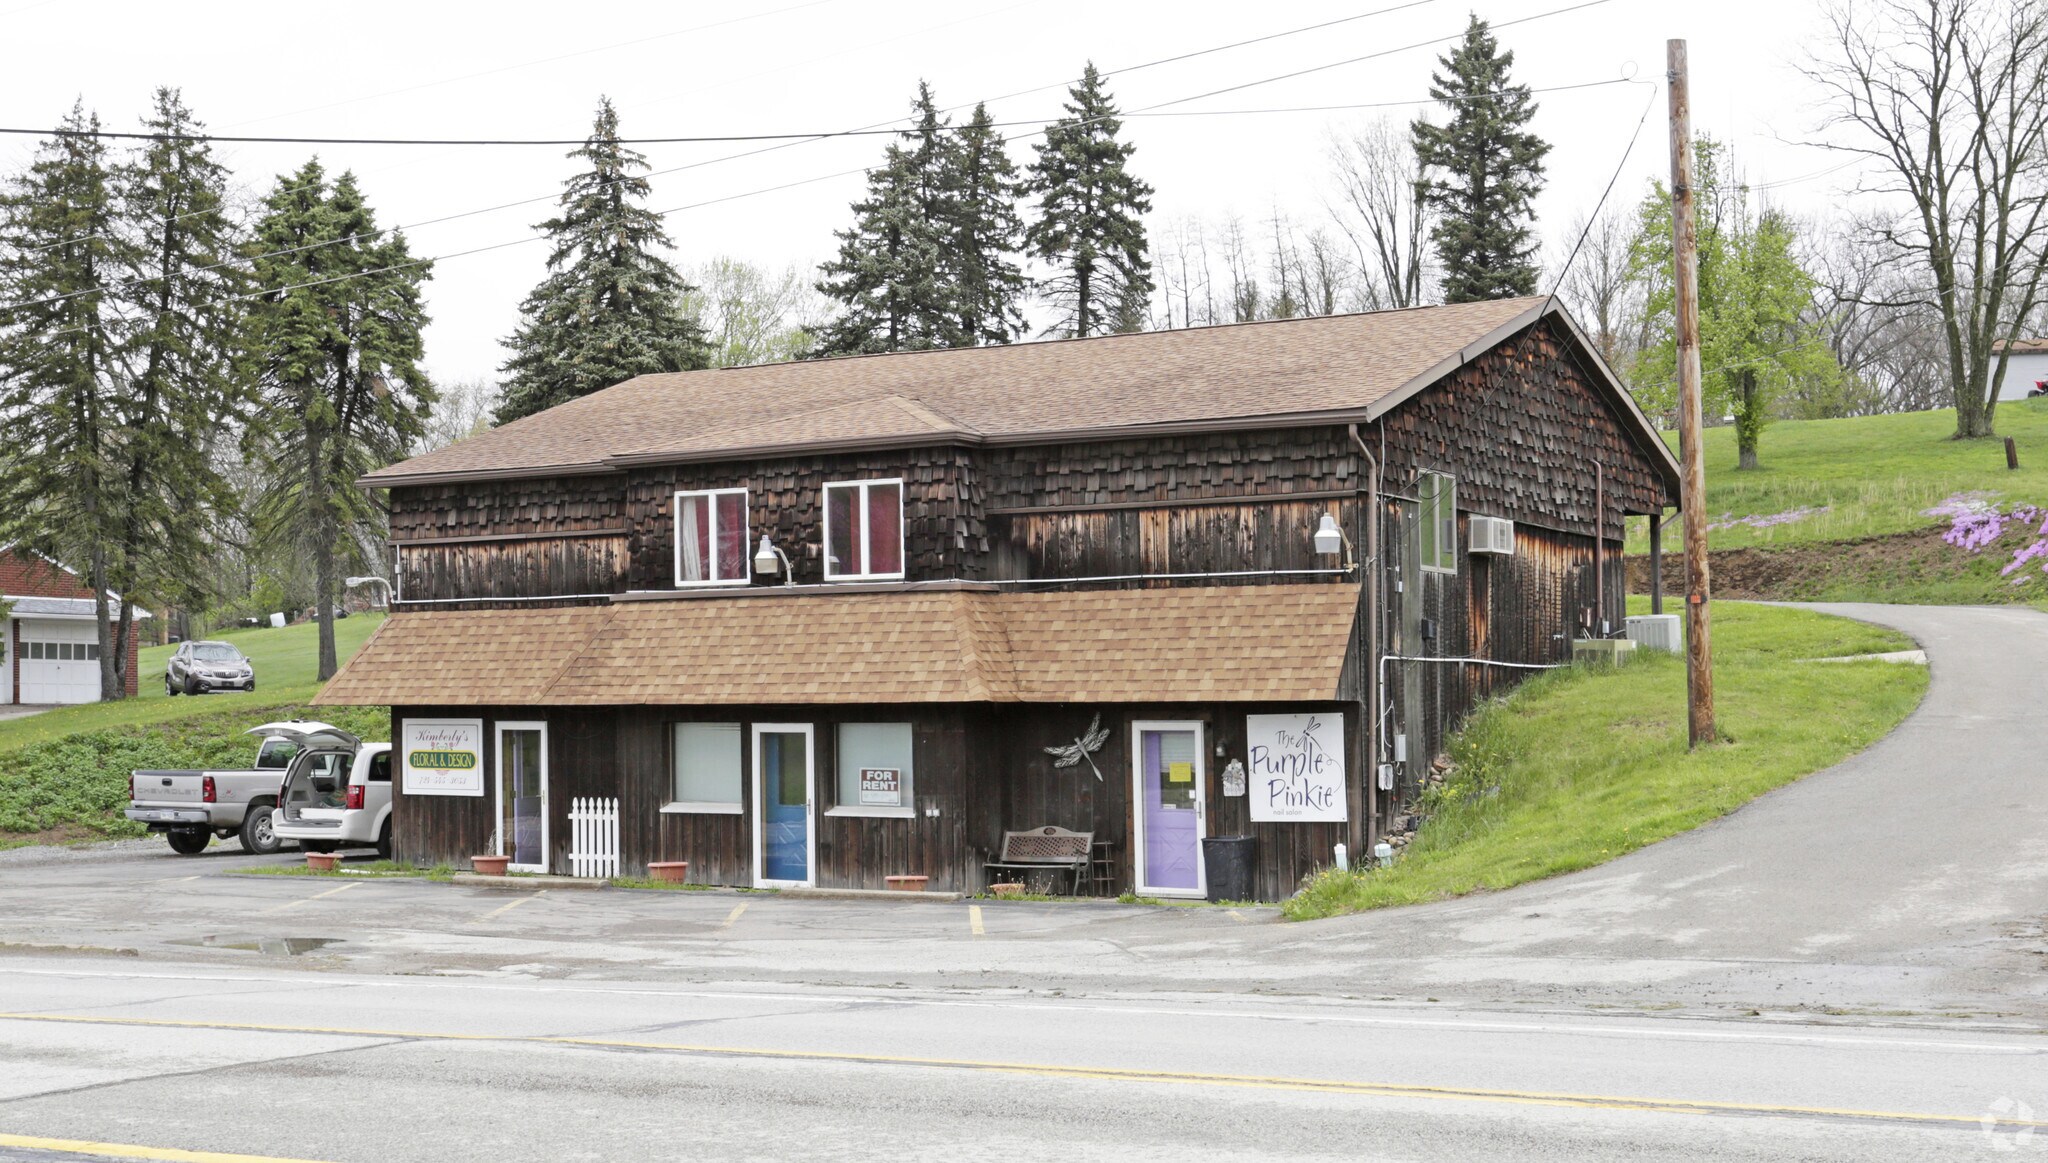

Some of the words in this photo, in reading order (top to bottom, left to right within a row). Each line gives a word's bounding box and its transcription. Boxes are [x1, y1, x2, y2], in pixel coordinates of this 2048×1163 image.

[415, 729, 469, 746] Kimberly's
[1275, 730, 1295, 748] The
[413, 753, 438, 767] FLORAL
[440, 753, 447, 767] &
[448, 753, 472, 767] DESIGN
[1251, 742, 1323, 786] Purple
[866, 771, 892, 780] FOR
[137, 787, 199, 796] CHEVROLET
[862, 781, 897, 790] RENT
[1268, 778, 1333, 811] Pinkie
